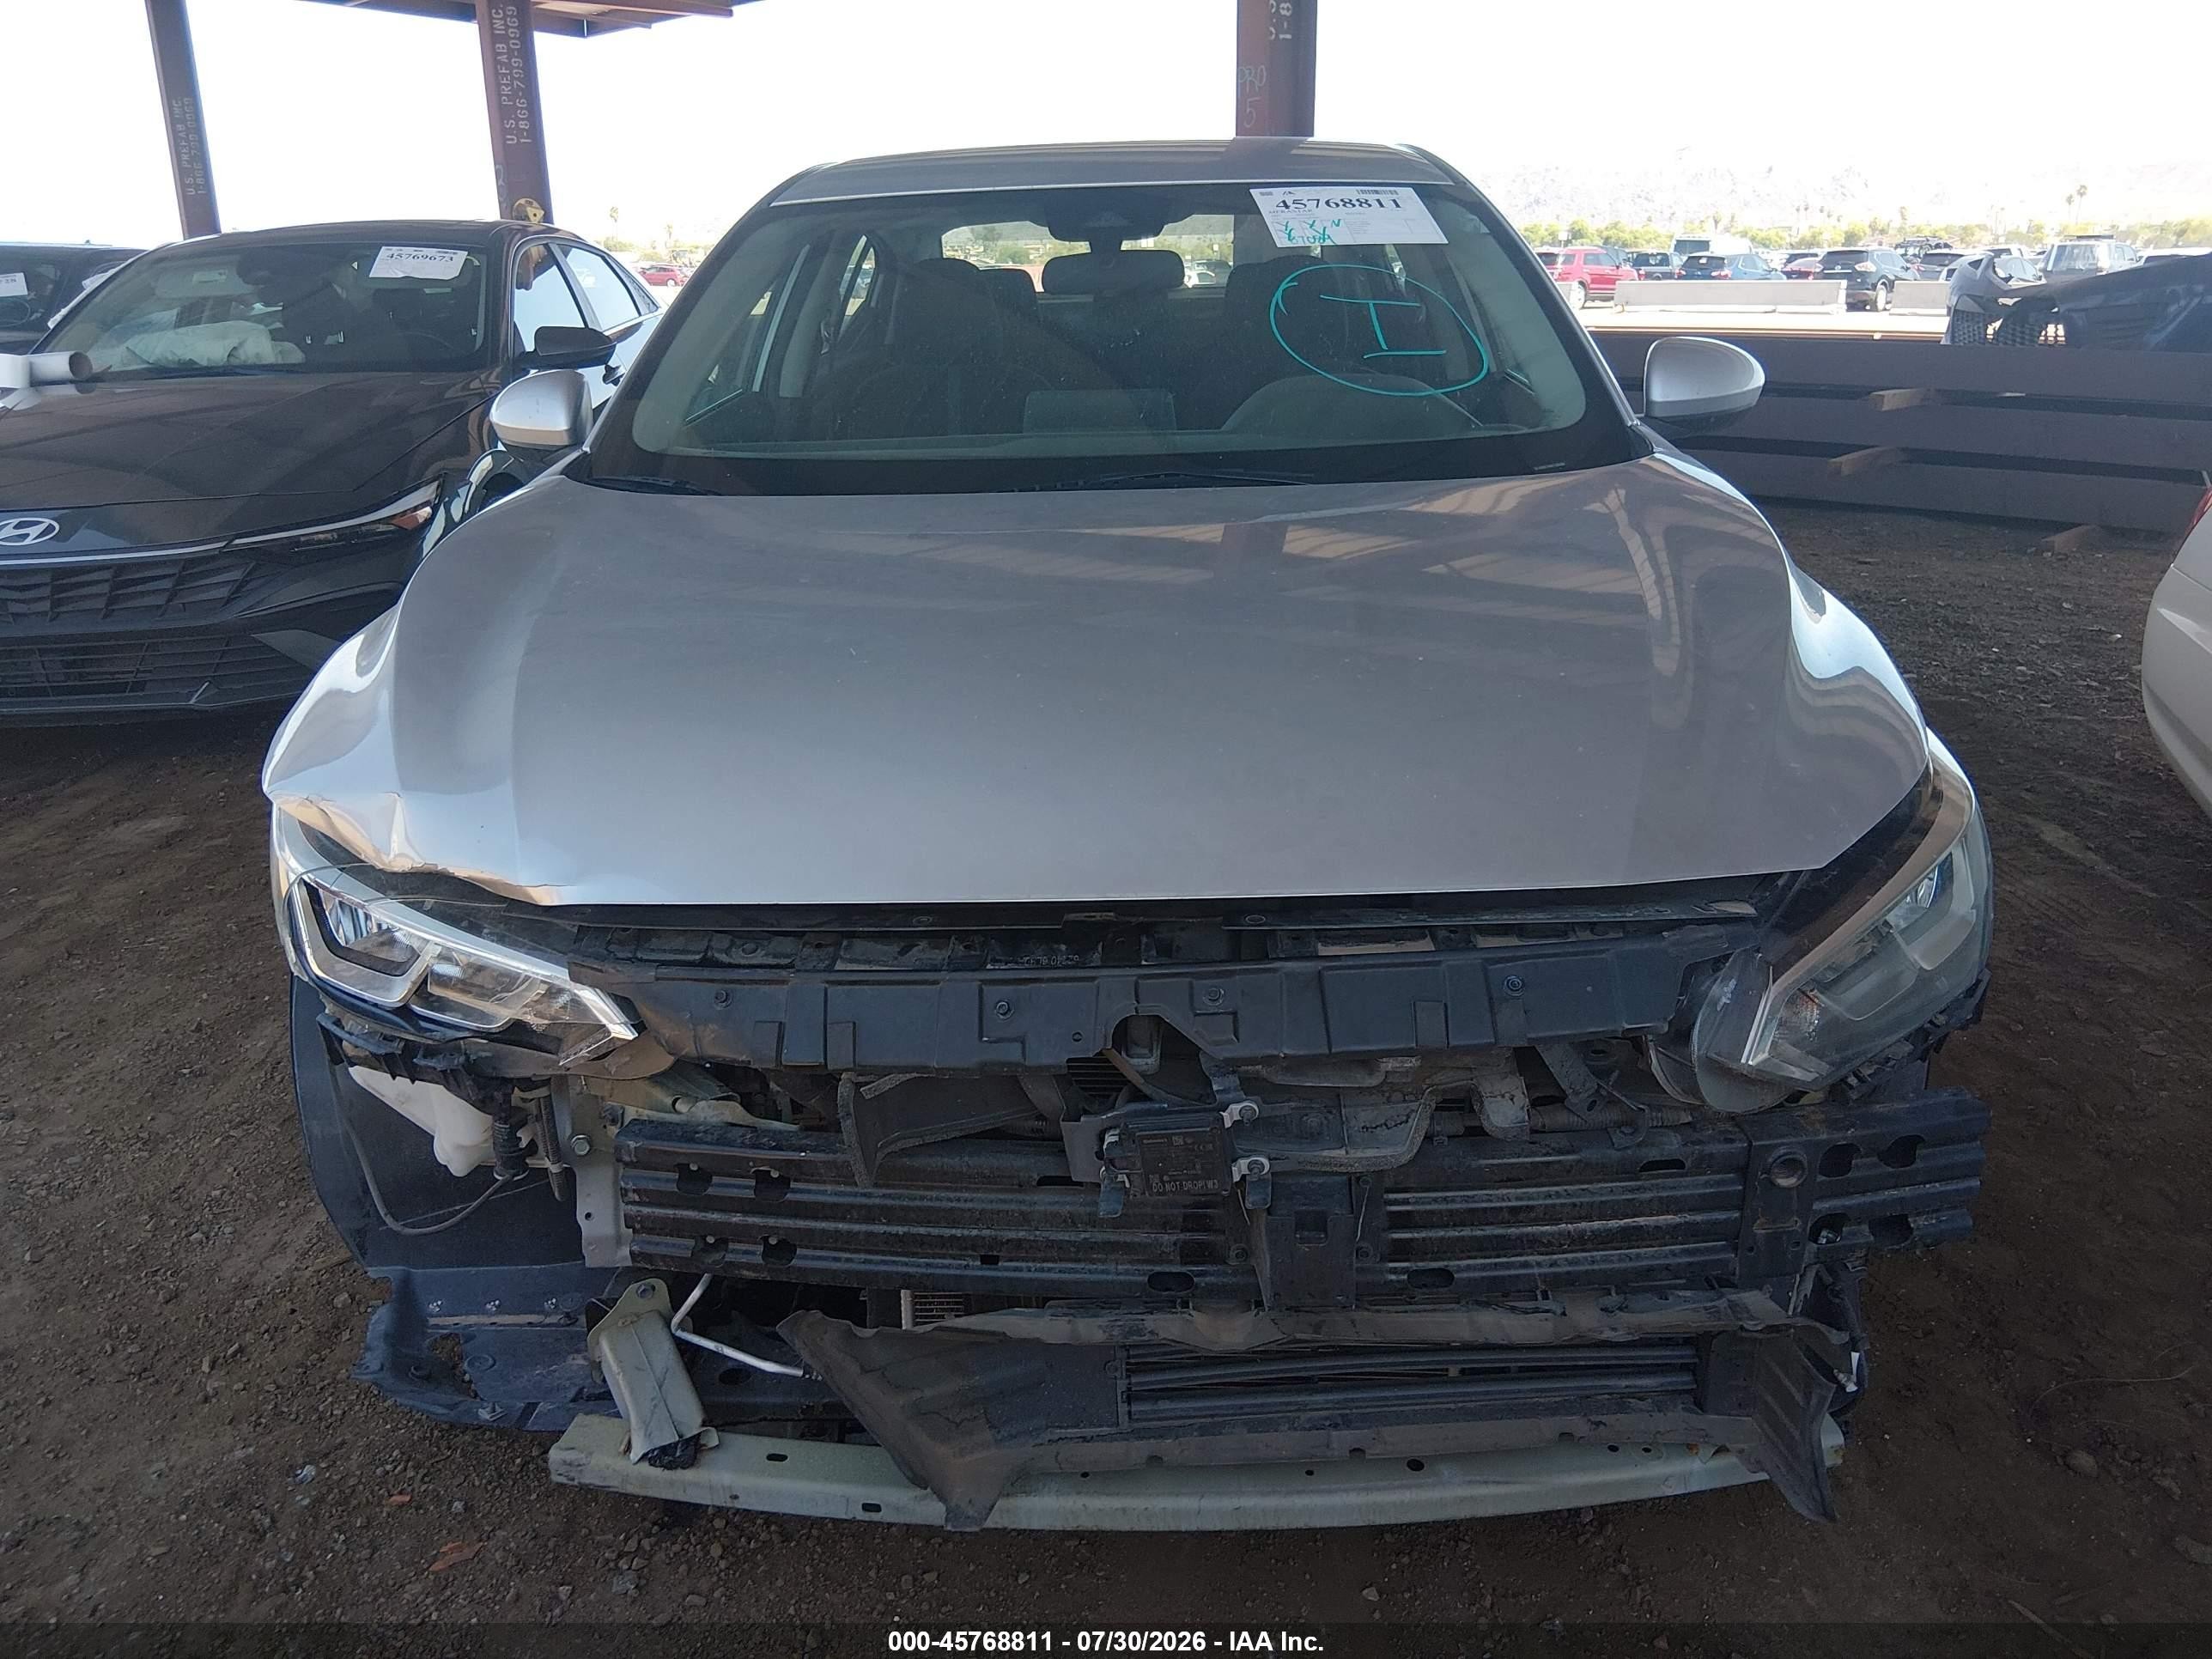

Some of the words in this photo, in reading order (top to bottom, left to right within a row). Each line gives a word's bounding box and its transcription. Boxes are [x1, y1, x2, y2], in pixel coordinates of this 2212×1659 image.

[491, 3, 506, 34] INC.
[495, 43, 514, 105] PREFAB
[506, 6, 532, 143] 1-866-799-0969
[503, 114, 518, 144] U.S.
[1276, 198, 1403, 210] 45768811
[386, 252, 454, 263] 45769673
[1152, 1181, 1164, 1192] DO
[1166, 1181, 1181, 1192] NOT
